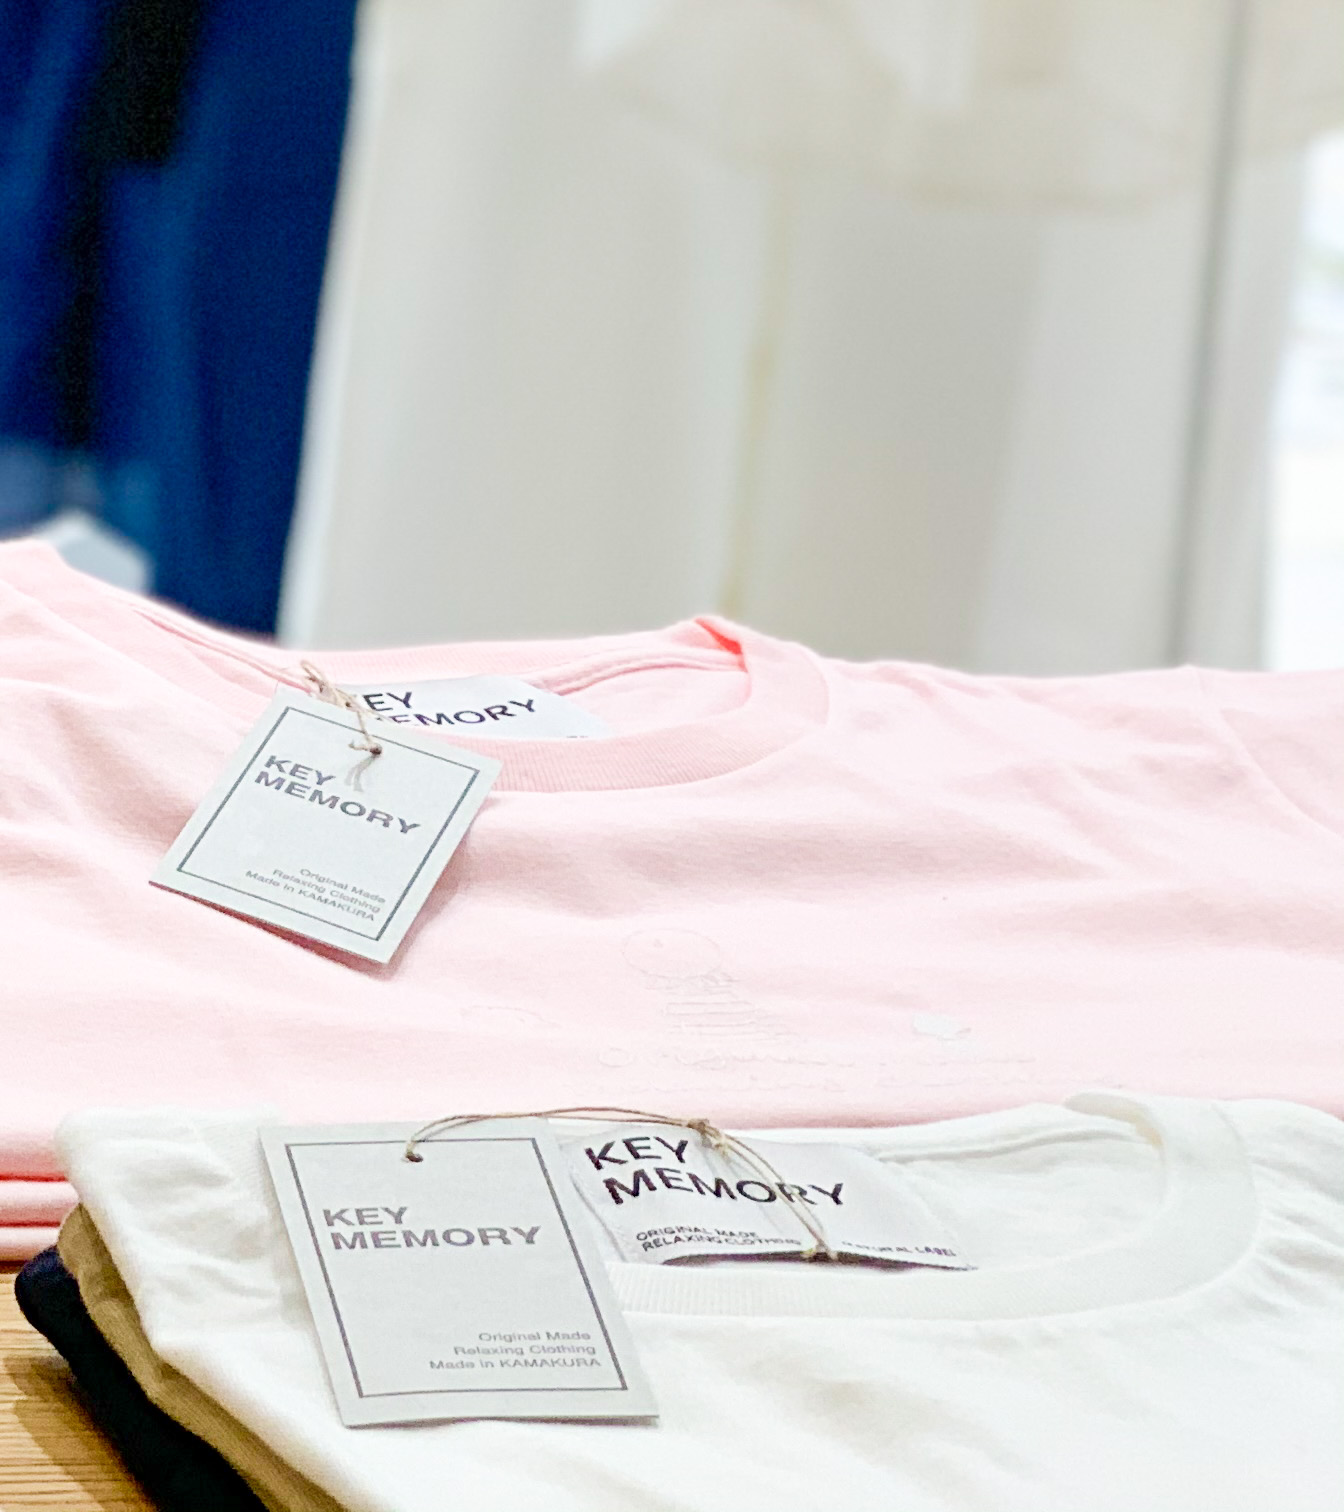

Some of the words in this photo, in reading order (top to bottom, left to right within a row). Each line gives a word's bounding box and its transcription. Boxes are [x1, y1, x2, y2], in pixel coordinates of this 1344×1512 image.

[362, 691, 413, 712] EY
[382, 698, 536, 728] EMORY
[264, 755, 336, 786] KEY
[254, 770, 421, 834] MEMORY
[245, 870, 281, 887] Made
[283, 883, 295, 893] in
[298, 888, 375, 921] KAMAKURA
[272, 869, 326, 894] Relaxing
[329, 889, 381, 914] Clothing
[300, 868, 349, 891] Original
[351, 885, 386, 904] Made
[585, 1136, 689, 1171] KEY
[603, 1167, 843, 1205] MEMORY
[323, 1206, 408, 1227] KEY
[331, 1225, 541, 1250] MEMORY
[636, 1225, 712, 1242] ORIGINAL
[641, 1234, 723, 1252] RELAXING
[454, 1345, 525, 1356] Relaxing
[529, 1344, 596, 1355] Clothing
[478, 1332, 541, 1343] Original
[546, 1331, 591, 1341] Made
[429, 1360, 476, 1370] Made
[480, 1359, 495, 1369] in
[499, 1358, 602, 1369] KAMAKURA
